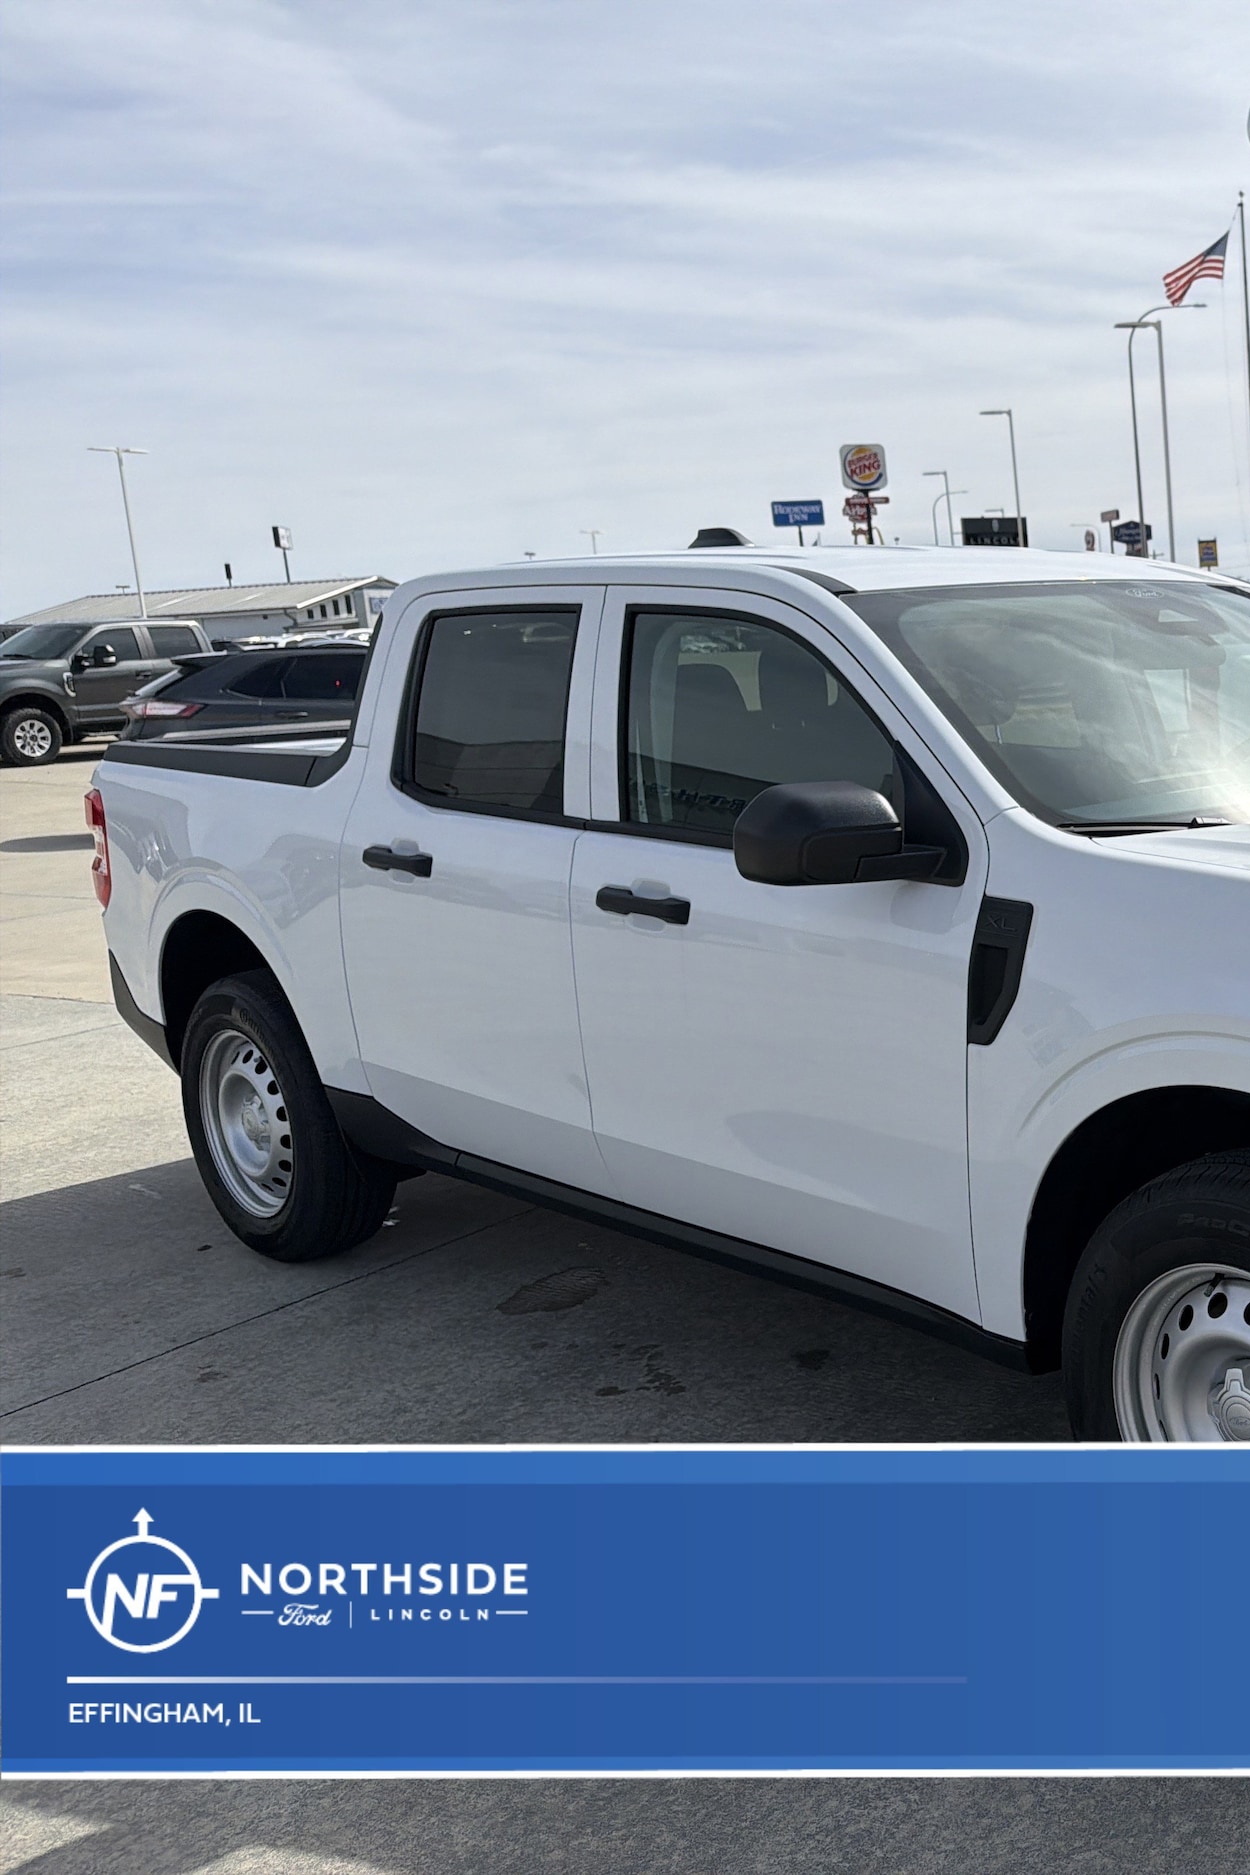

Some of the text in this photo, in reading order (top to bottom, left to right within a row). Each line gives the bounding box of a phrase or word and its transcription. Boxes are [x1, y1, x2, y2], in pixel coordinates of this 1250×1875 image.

[848, 452, 879, 468] BURGER
[850, 461, 881, 479] KING
[969, 536, 1021, 545] LINCOL
[985, 911, 1016, 931] XL
